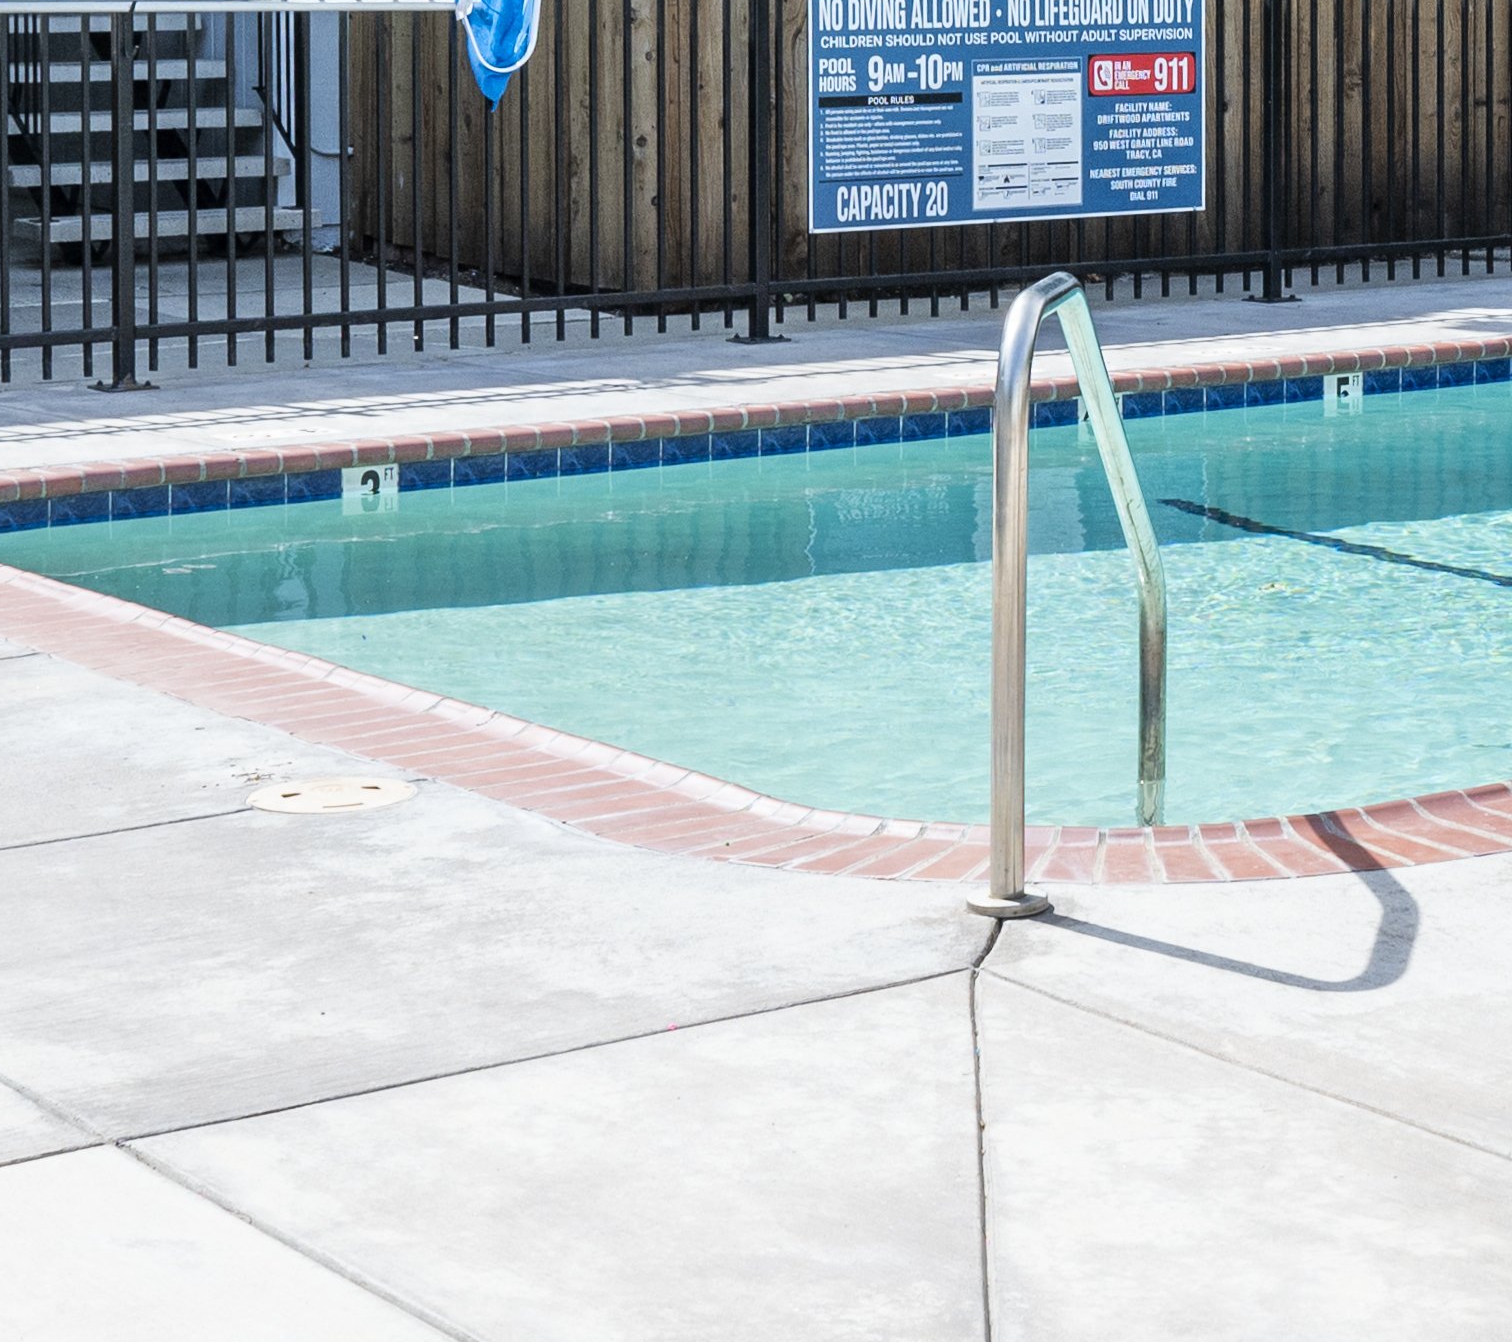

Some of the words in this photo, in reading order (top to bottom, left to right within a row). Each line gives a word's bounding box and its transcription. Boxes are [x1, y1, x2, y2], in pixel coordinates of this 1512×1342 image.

[820, 35, 882, 49] CHILDREN
[885, 34, 935, 47] SHOULD
[938, 33, 962, 46] NOT
[964, 32, 988, 45] USE
[990, 31, 1022, 45] POOL
[1025, 30, 1079, 44] WITHOUT
[1081, 29, 1117, 42] ADULT
[1119, 28, 1193, 41] SUPERVISION
[819, 58, 855, 75] POOL
[1154, 57, 1189, 91] 911
[819, 75, 856, 92] HOURS
[868, 96, 889, 105] POOL
[890, 95, 915, 104] RULES
[1115, 102, 1148, 113] FACILITY
[1149, 101, 1172, 112] NAME:
[1097, 114, 1141, 125] DRIFTWOOD
[1141, 112, 1190, 123] APARTMENTS
[1109, 128, 1142, 139] FACILITY
[1142, 127, 1178, 137] ADDRESS:
[1093, 141, 1109, 151] 950
[1109, 140, 1130, 150] WEST
[1130, 139, 1155, 149] GRANT
[1156, 138, 1173, 148] LINE
[1174, 137, 1194, 147] ROAD
[1152, 149, 1162, 159] CA
[1089, 168, 1121, 179] NEAREST
[1122, 166, 1162, 177] EMERGENCY
[1163, 164, 1197, 175] SERVICES:
[1110, 180, 1133, 190] SOUTH
[1134, 178, 1161, 189] COUNTY
[1162, 177, 1177, 188] FIRE
[837, 183, 922, 223] CAPACITY
[925, 181, 949, 217] 20
[1146, 190, 1158, 200] 911
[1337, 376, 1350, 398] 5
[1353, 375, 1360, 386] FT
[384, 467, 394, 481] FT
